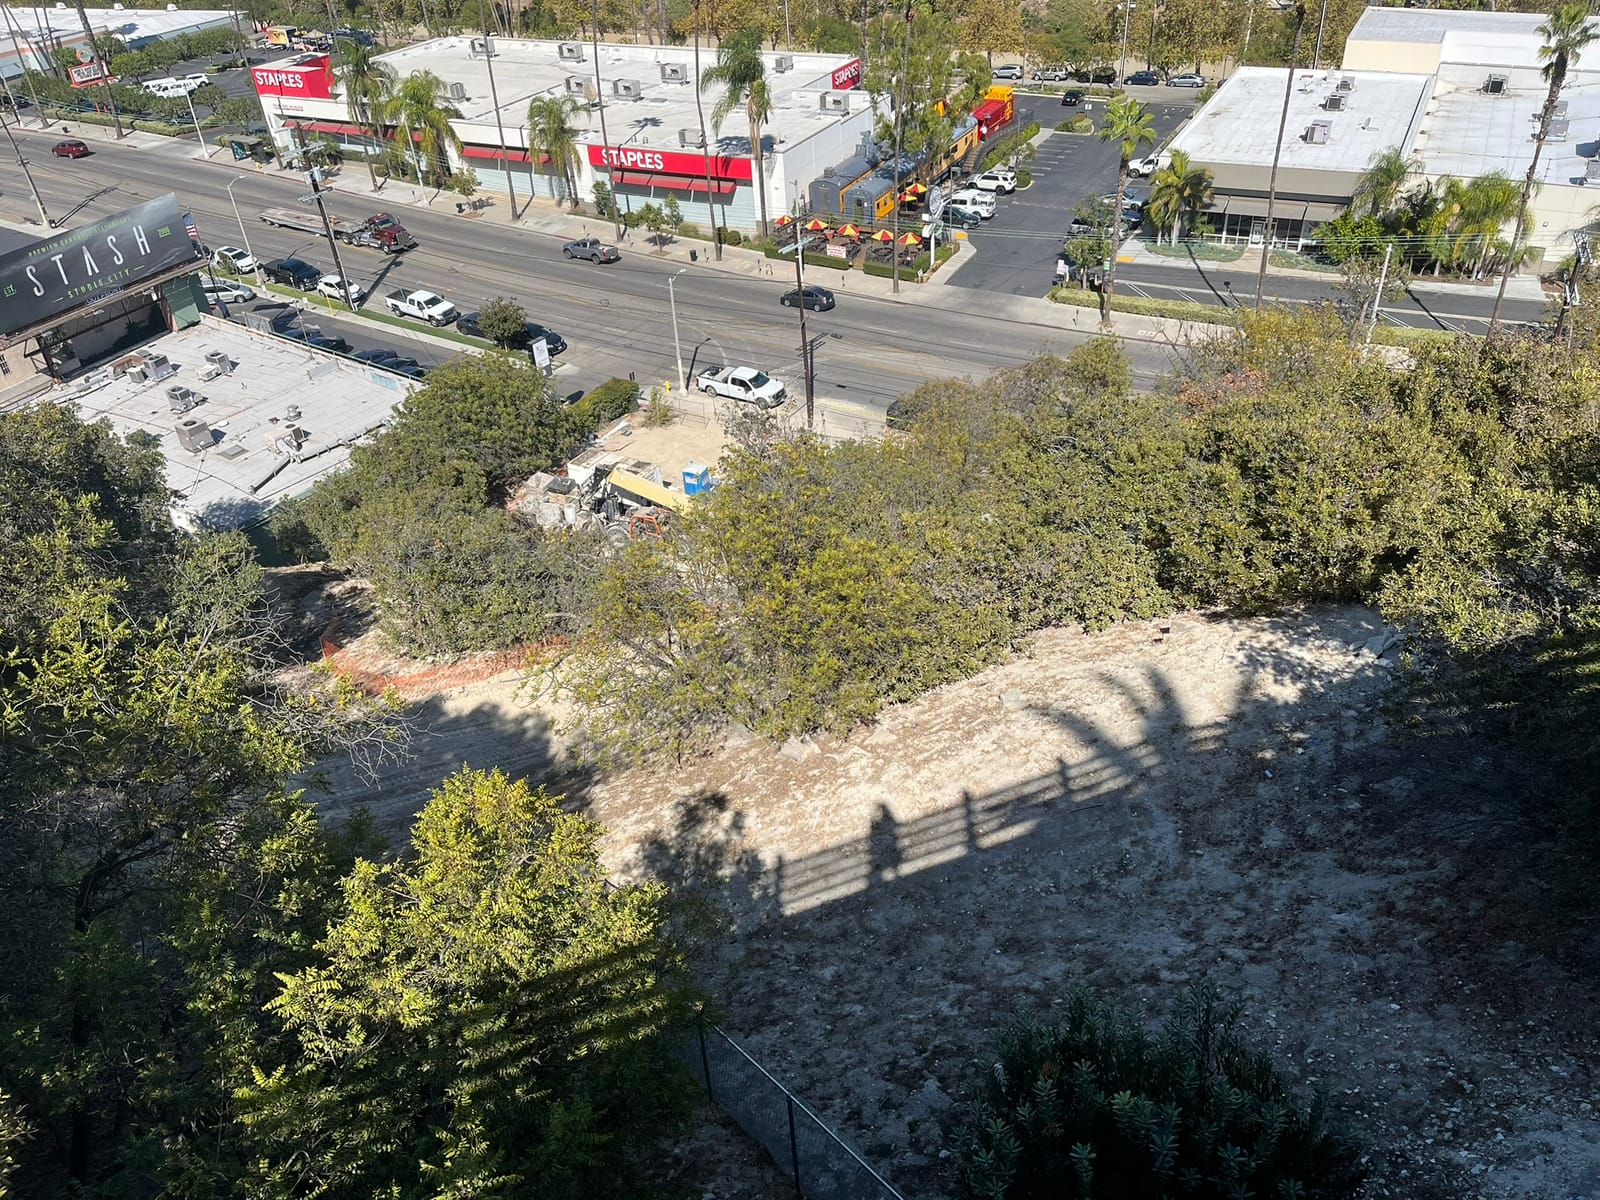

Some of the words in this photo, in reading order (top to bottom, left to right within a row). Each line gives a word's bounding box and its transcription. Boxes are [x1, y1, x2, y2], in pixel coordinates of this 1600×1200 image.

[255, 71, 304, 89] STAPLES
[834, 62, 859, 86] STAPLES
[601, 149, 664, 170] STAPLES
[25, 224, 151, 297] STASH
[67, 279, 104, 299] STUDIO
[107, 268, 131, 283] CITY
